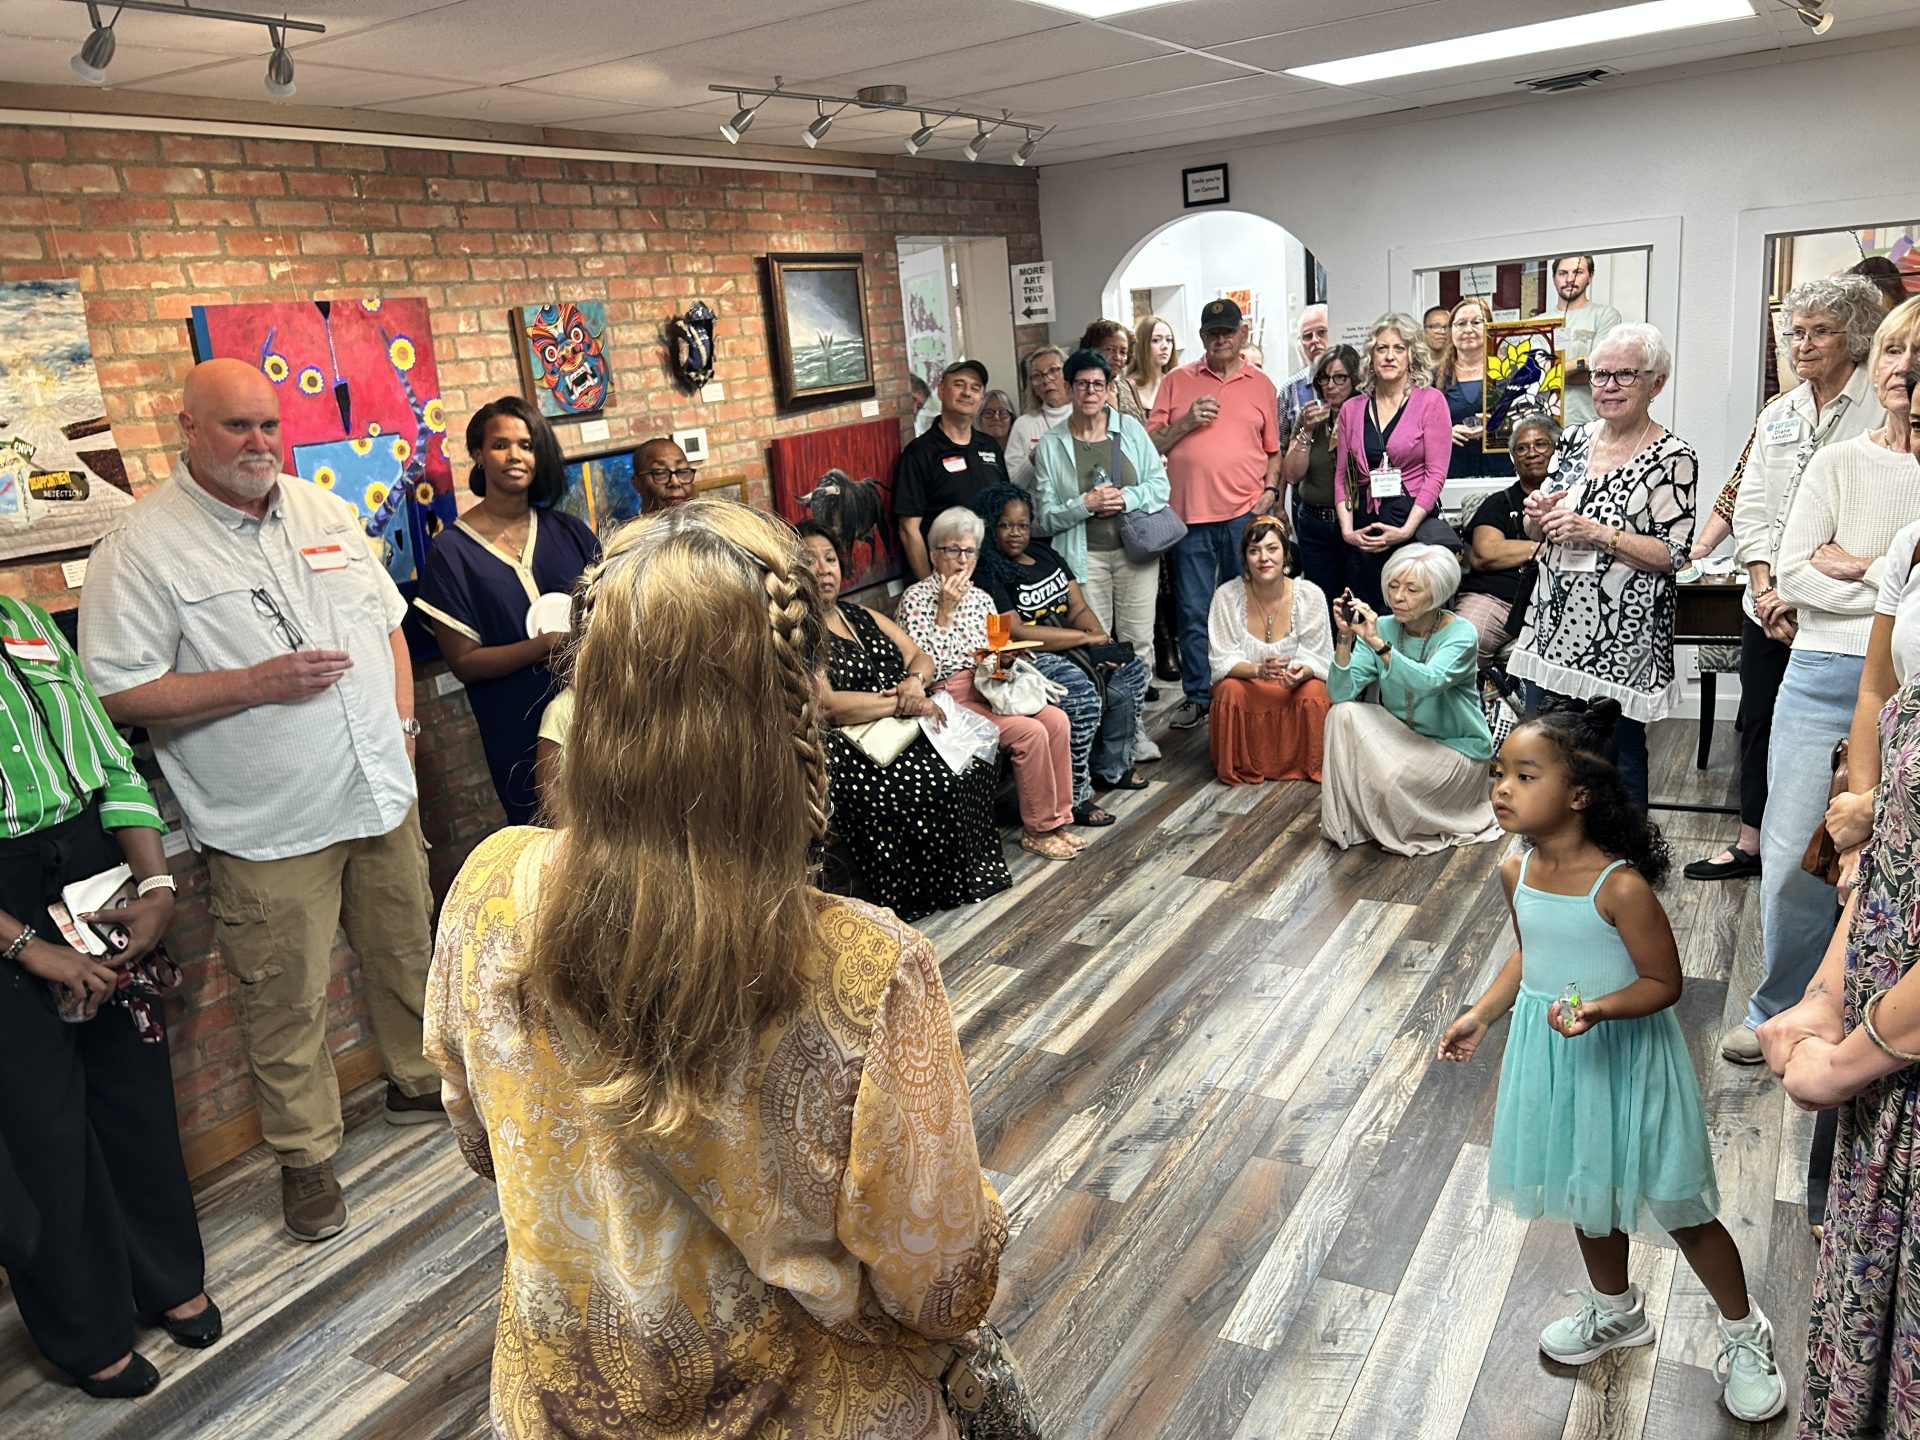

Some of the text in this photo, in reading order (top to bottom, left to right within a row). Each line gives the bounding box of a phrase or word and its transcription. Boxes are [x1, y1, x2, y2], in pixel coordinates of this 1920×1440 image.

[1019, 266, 1045, 276] MORE
[1023, 276, 1042, 285] ART
[1022, 285, 1044, 294] THIS
[1023, 295, 1043, 304] WAY
[43, 489, 83, 499] REJECTION
[1019, 581, 1058, 605] GOTTA
